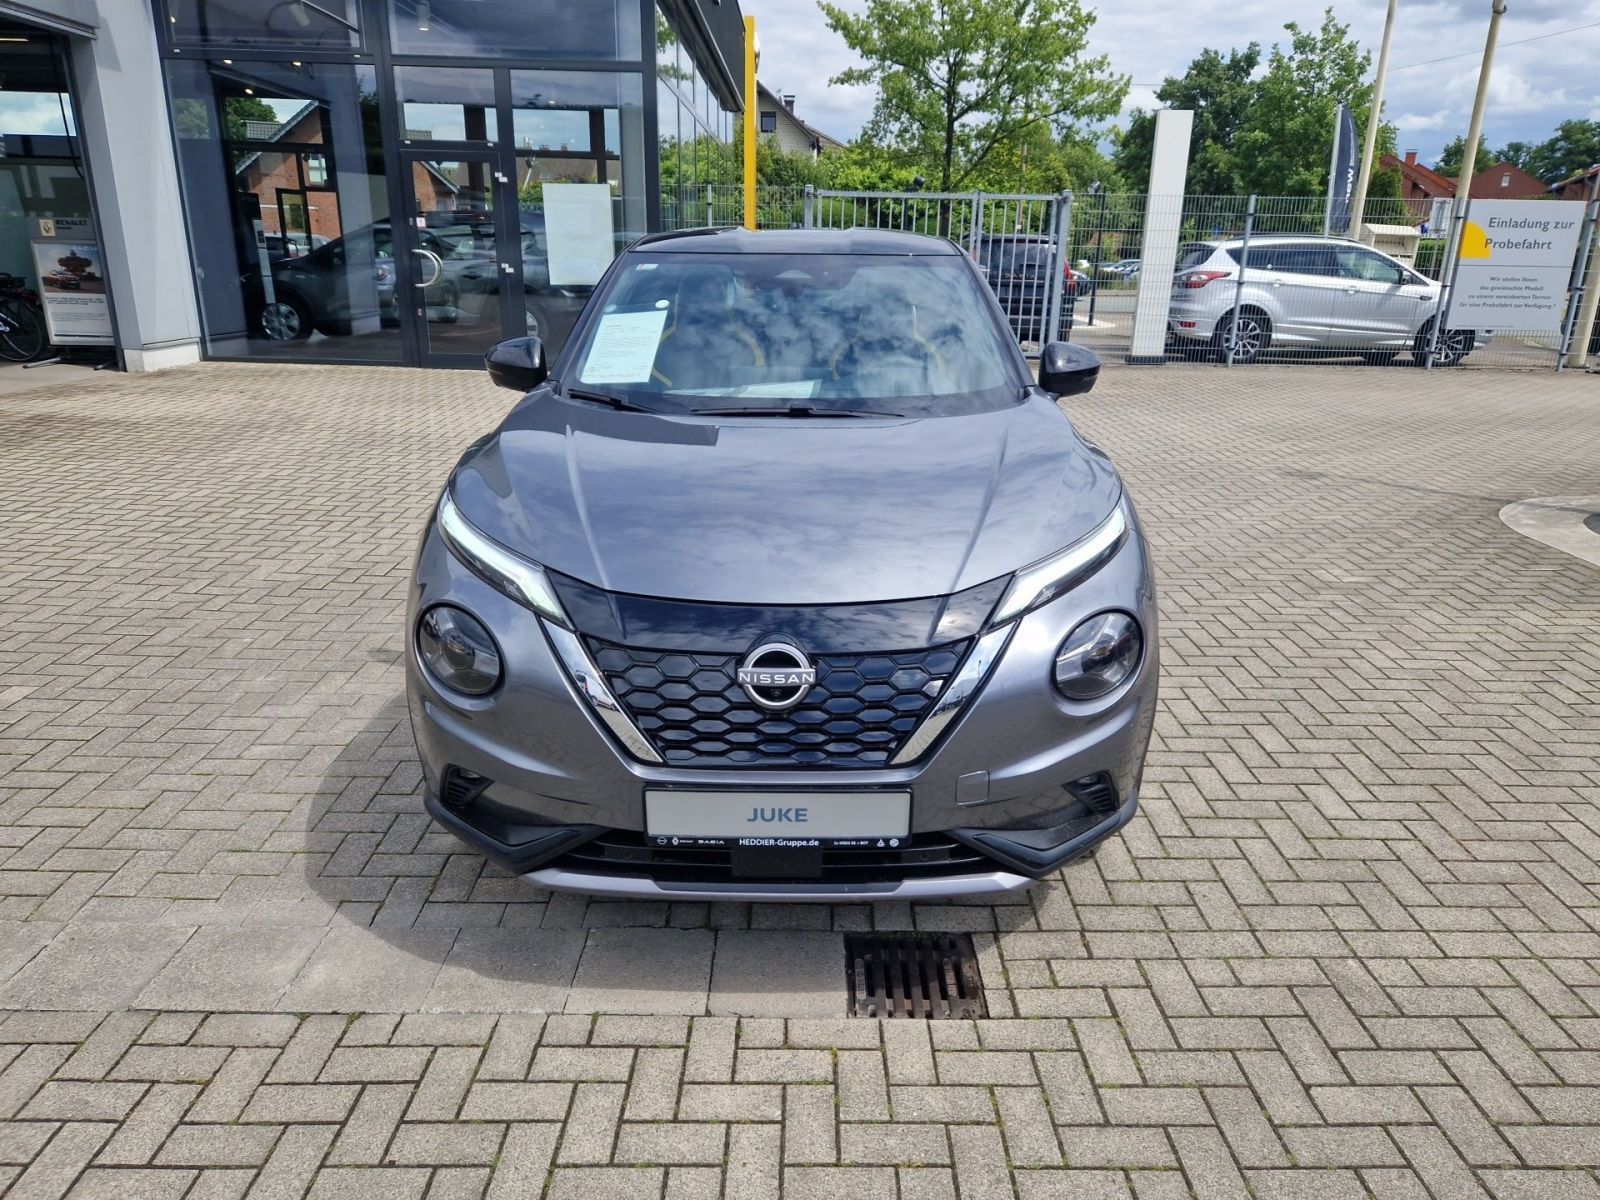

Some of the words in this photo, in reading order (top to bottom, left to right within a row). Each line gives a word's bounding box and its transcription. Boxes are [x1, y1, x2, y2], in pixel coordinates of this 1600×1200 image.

[1488, 217, 1550, 232] Einladung
[1553, 220, 1575, 230] zur
[1484, 237, 1553, 250] Probefahrt
[738, 672, 815, 684] NISSAN
[746, 807, 809, 823] JUKE
[738, 837, 820, 848] HEDDIER-Gruppe.de
